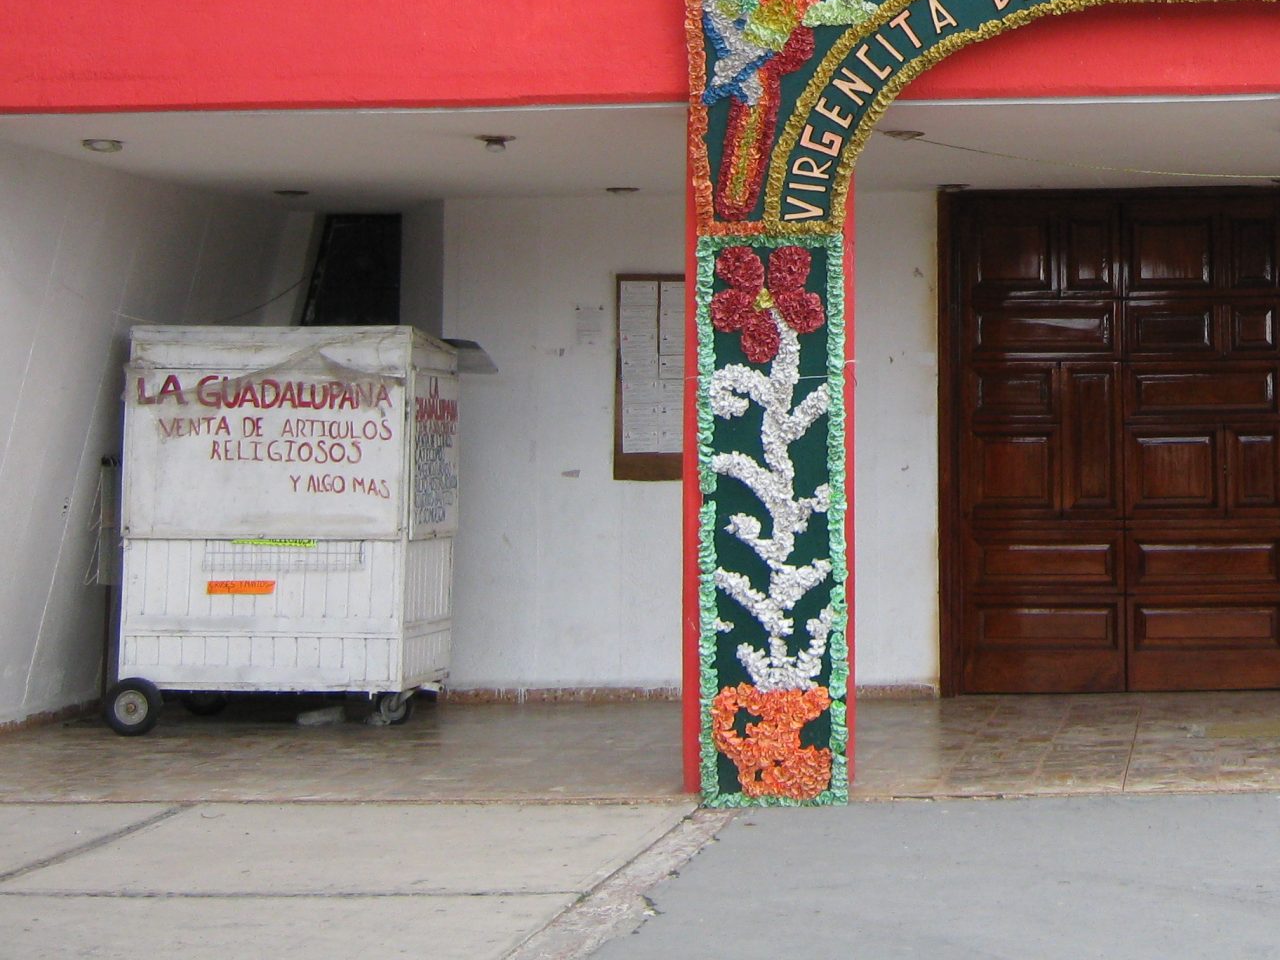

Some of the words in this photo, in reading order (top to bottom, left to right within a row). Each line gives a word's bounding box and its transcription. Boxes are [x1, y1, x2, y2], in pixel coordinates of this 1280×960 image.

[137, 374, 189, 406] LA
[197, 375, 393, 410] GUADALUPANA
[159, 415, 231, 437] VENTA
[242, 416, 265, 438] DE
[281, 418, 393, 441] ARTICULOS
[210, 440, 363, 464] RELIGIOSOS
[289, 474, 301, 493] Y
[307, 474, 346, 494] ALGO
[352, 476, 391, 499] MAS
